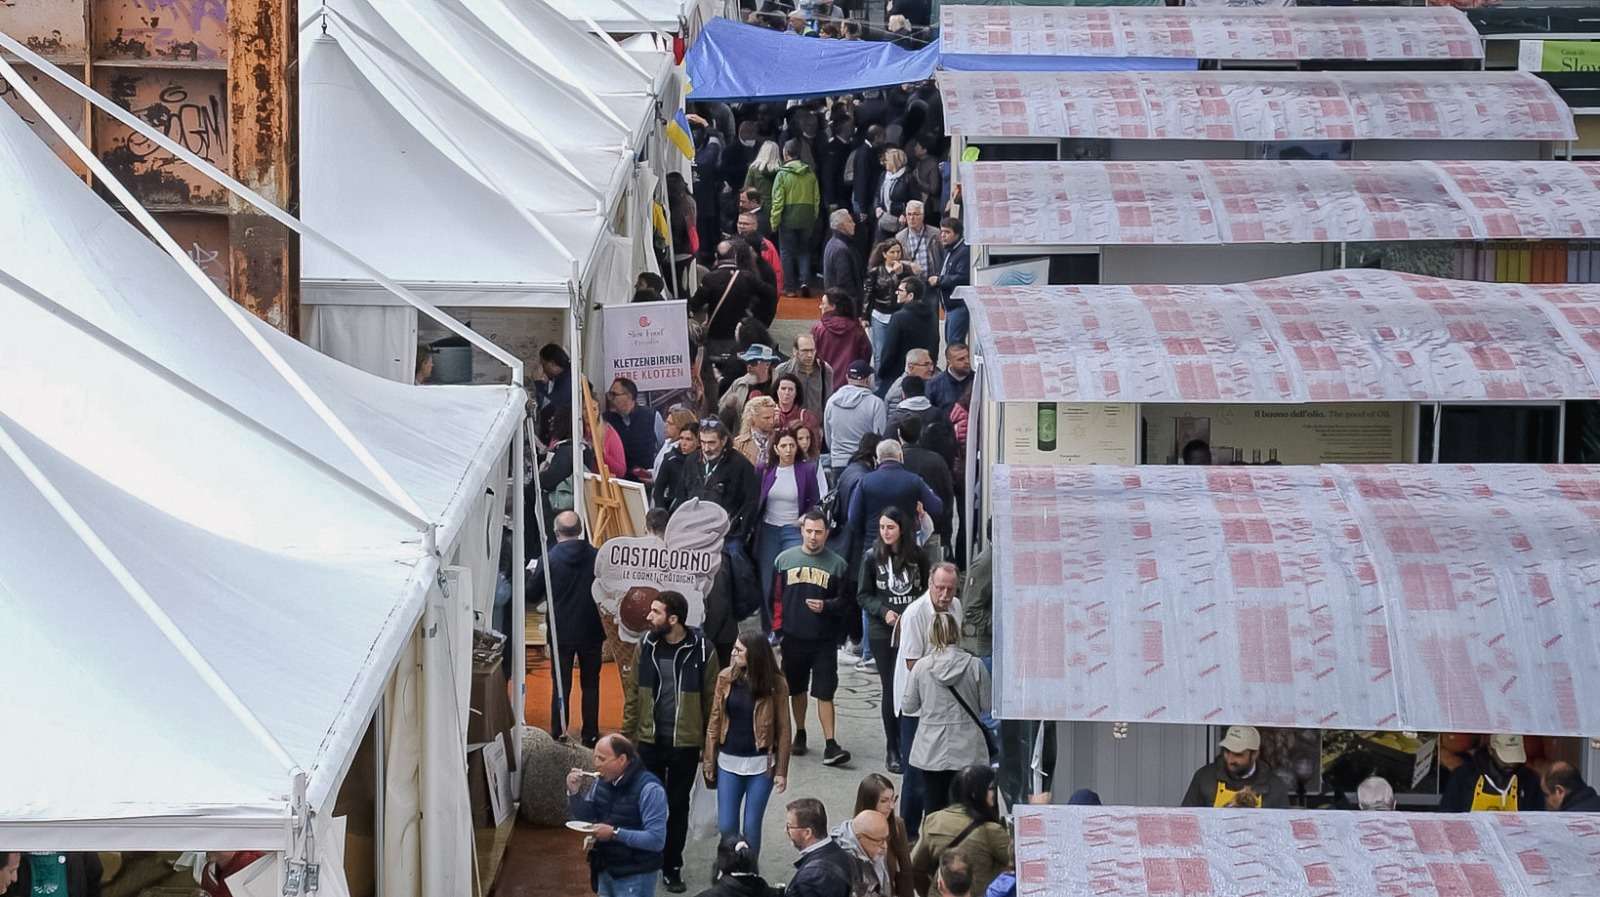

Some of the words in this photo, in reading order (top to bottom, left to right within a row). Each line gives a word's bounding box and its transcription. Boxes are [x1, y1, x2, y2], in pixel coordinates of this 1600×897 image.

[613, 355, 683, 369] KLETZENBIRNEN
[641, 368, 684, 380] KLOTZEN
[623, 570, 630, 579] LE
